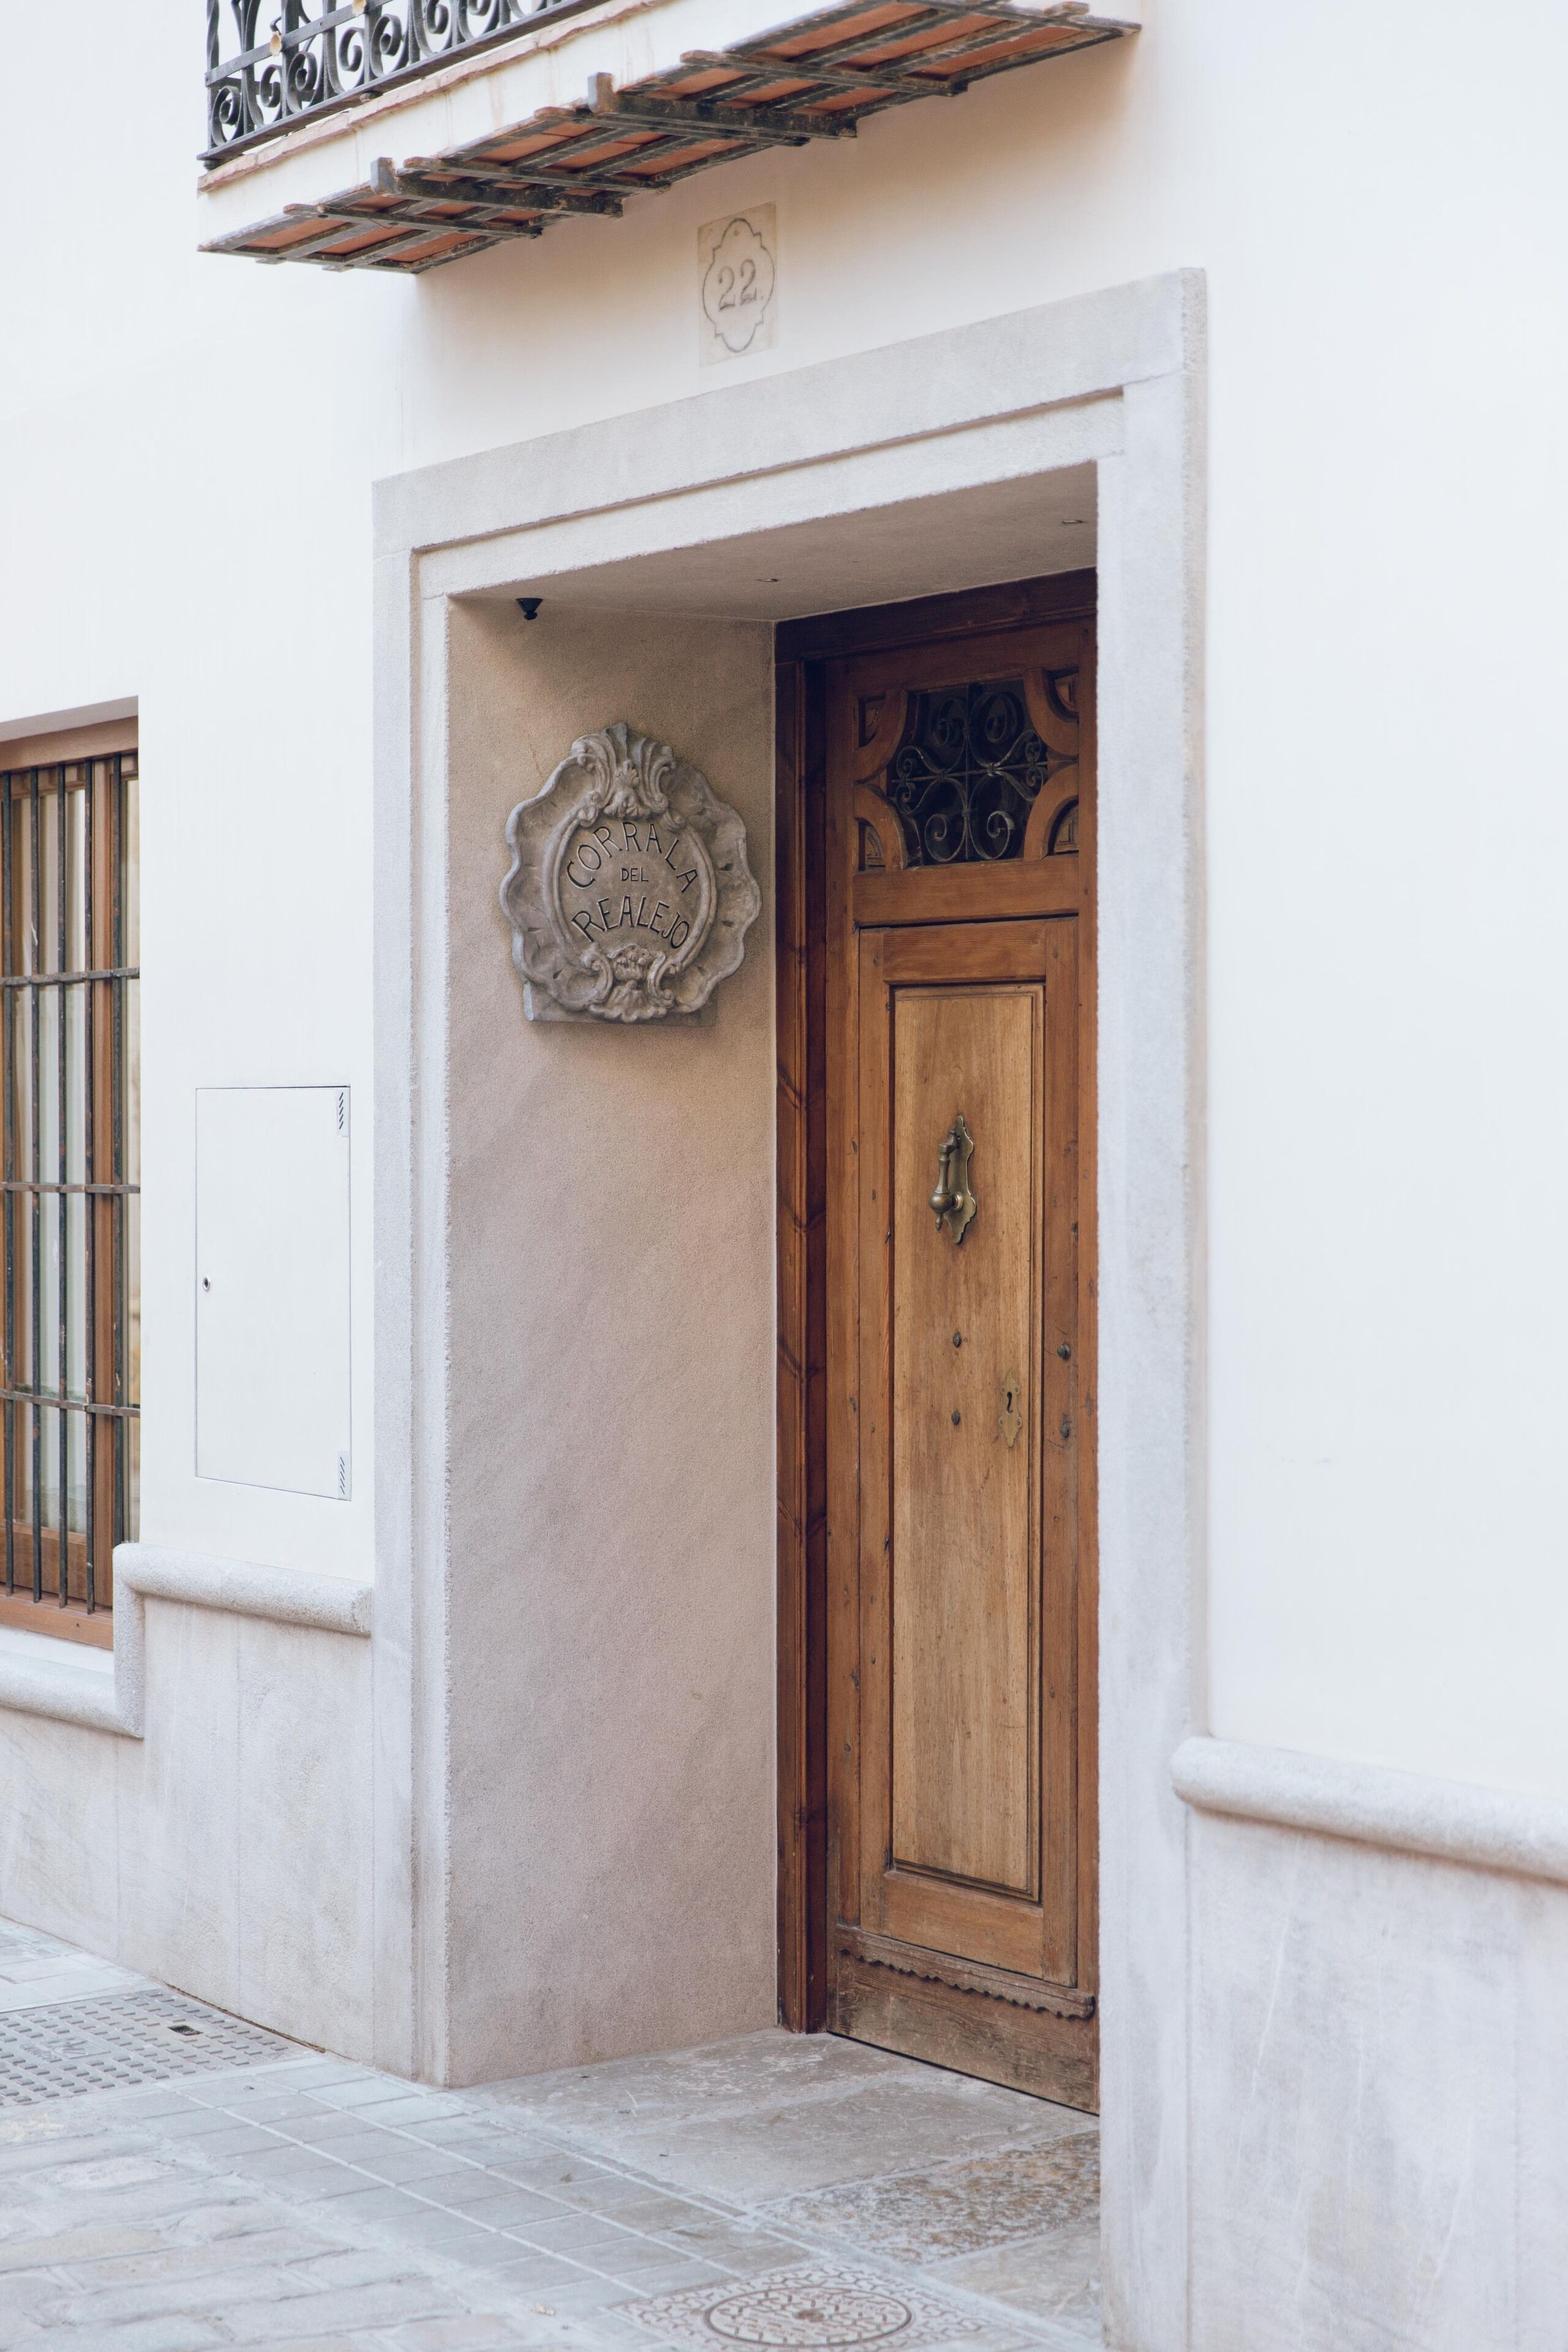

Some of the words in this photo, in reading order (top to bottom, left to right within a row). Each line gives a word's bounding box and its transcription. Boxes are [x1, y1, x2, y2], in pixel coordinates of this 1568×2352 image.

[718, 259, 757, 311] 22
[566, 821, 699, 893] CORRALA
[620, 867, 649, 882] DEL
[571, 895, 690, 949] REALEJO
